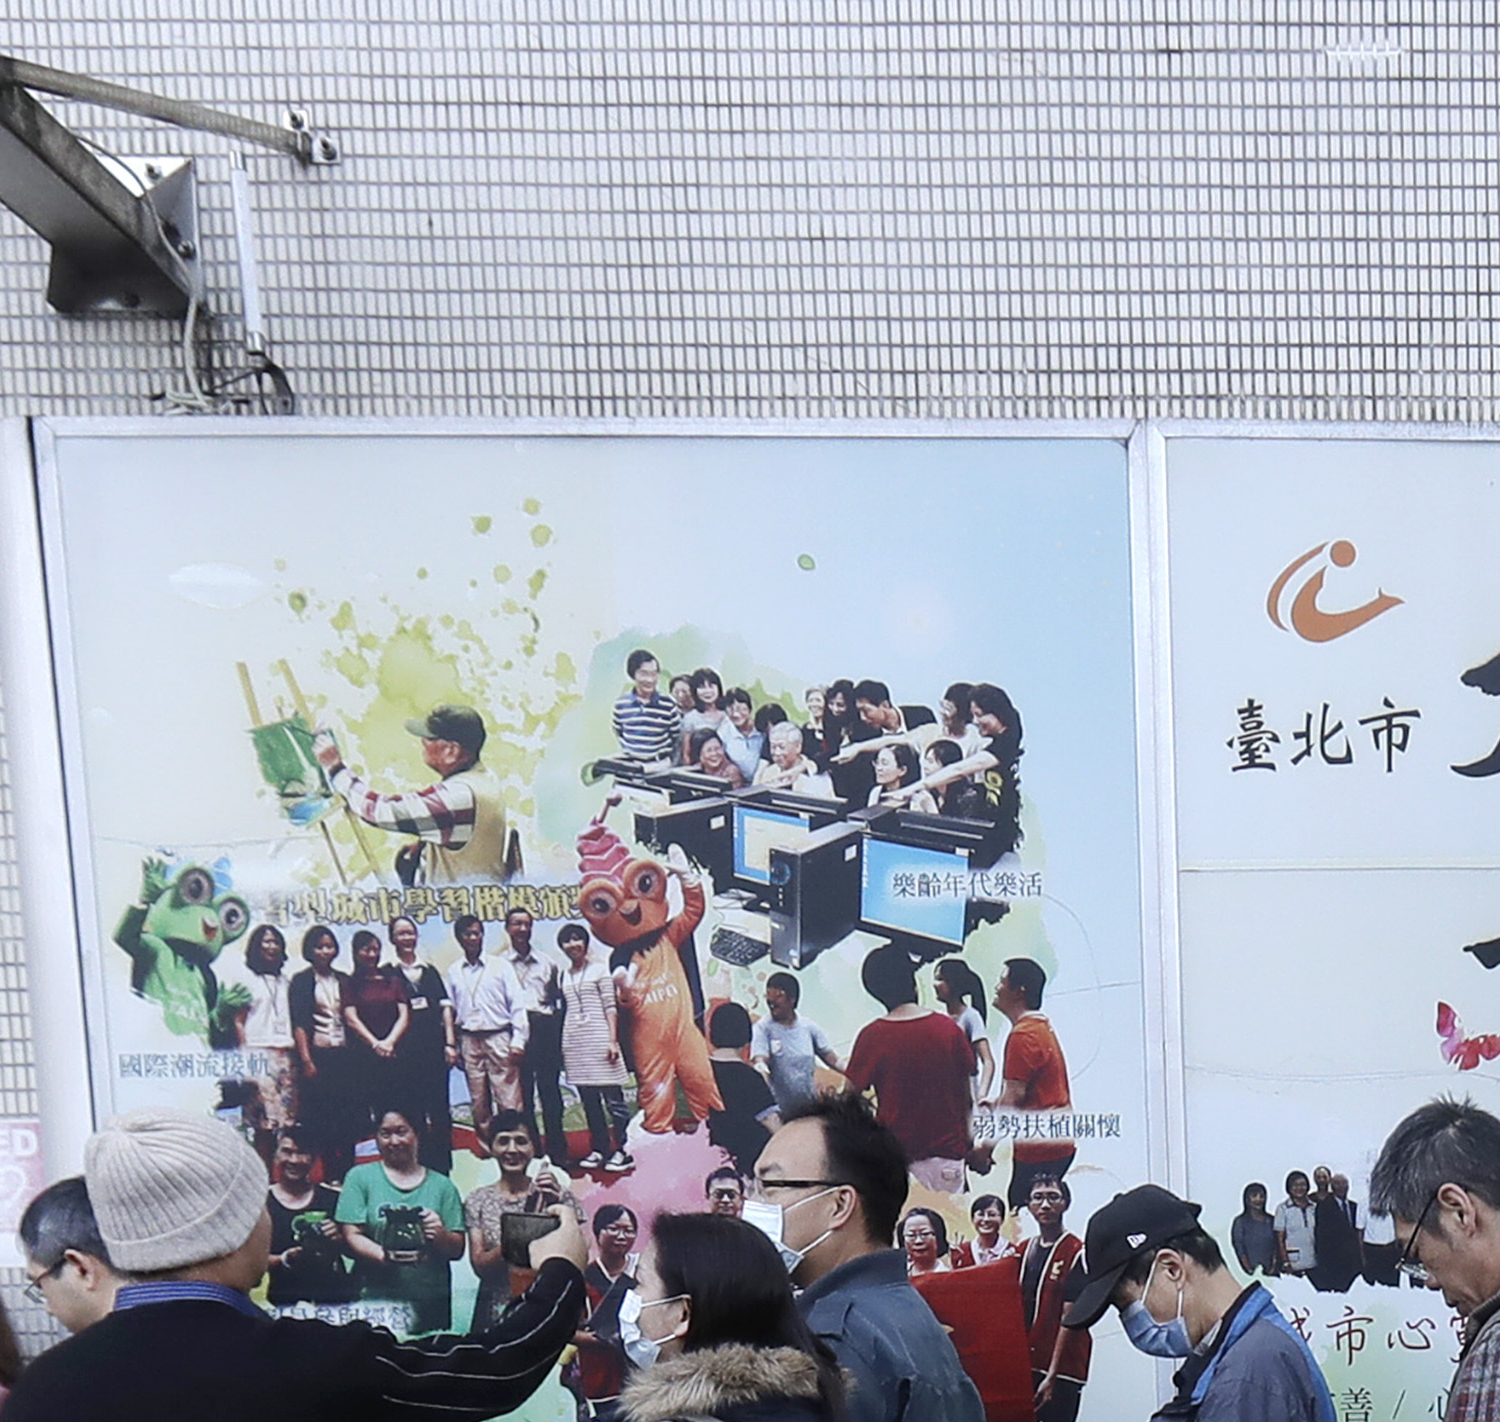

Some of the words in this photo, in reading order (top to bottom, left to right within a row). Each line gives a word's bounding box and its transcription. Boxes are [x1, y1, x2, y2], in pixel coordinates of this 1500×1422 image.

[1225, 696, 1422, 775] 臺北市
[892, 870, 1043, 898] 樂齡年代樂活
[973, 1113, 1121, 1139] 弱勢扶植關懷
